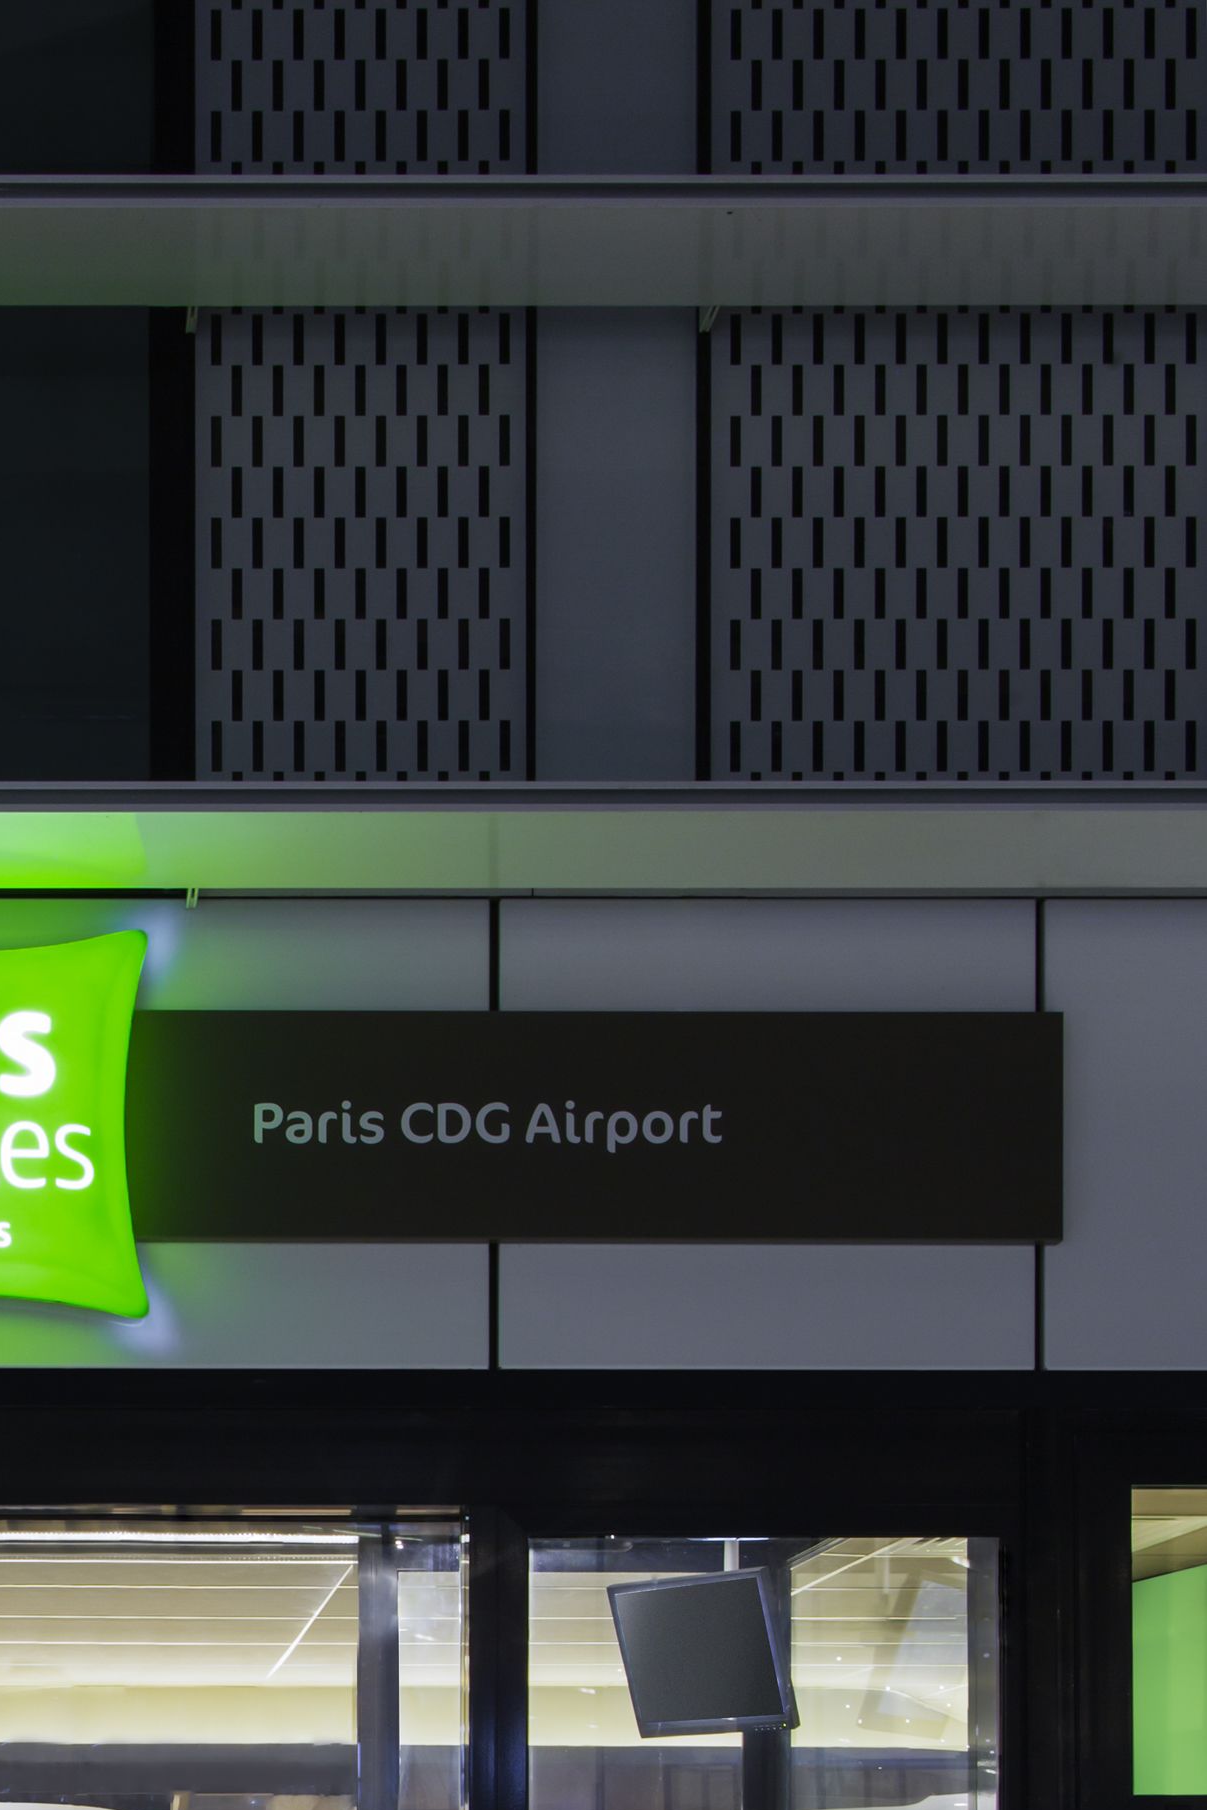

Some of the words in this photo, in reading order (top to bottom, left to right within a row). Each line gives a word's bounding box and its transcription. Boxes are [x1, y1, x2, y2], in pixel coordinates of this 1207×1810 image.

[253, 1100, 385, 1144] Paris
[400, 1101, 511, 1144] CDG
[525, 1100, 723, 1154] Airport
